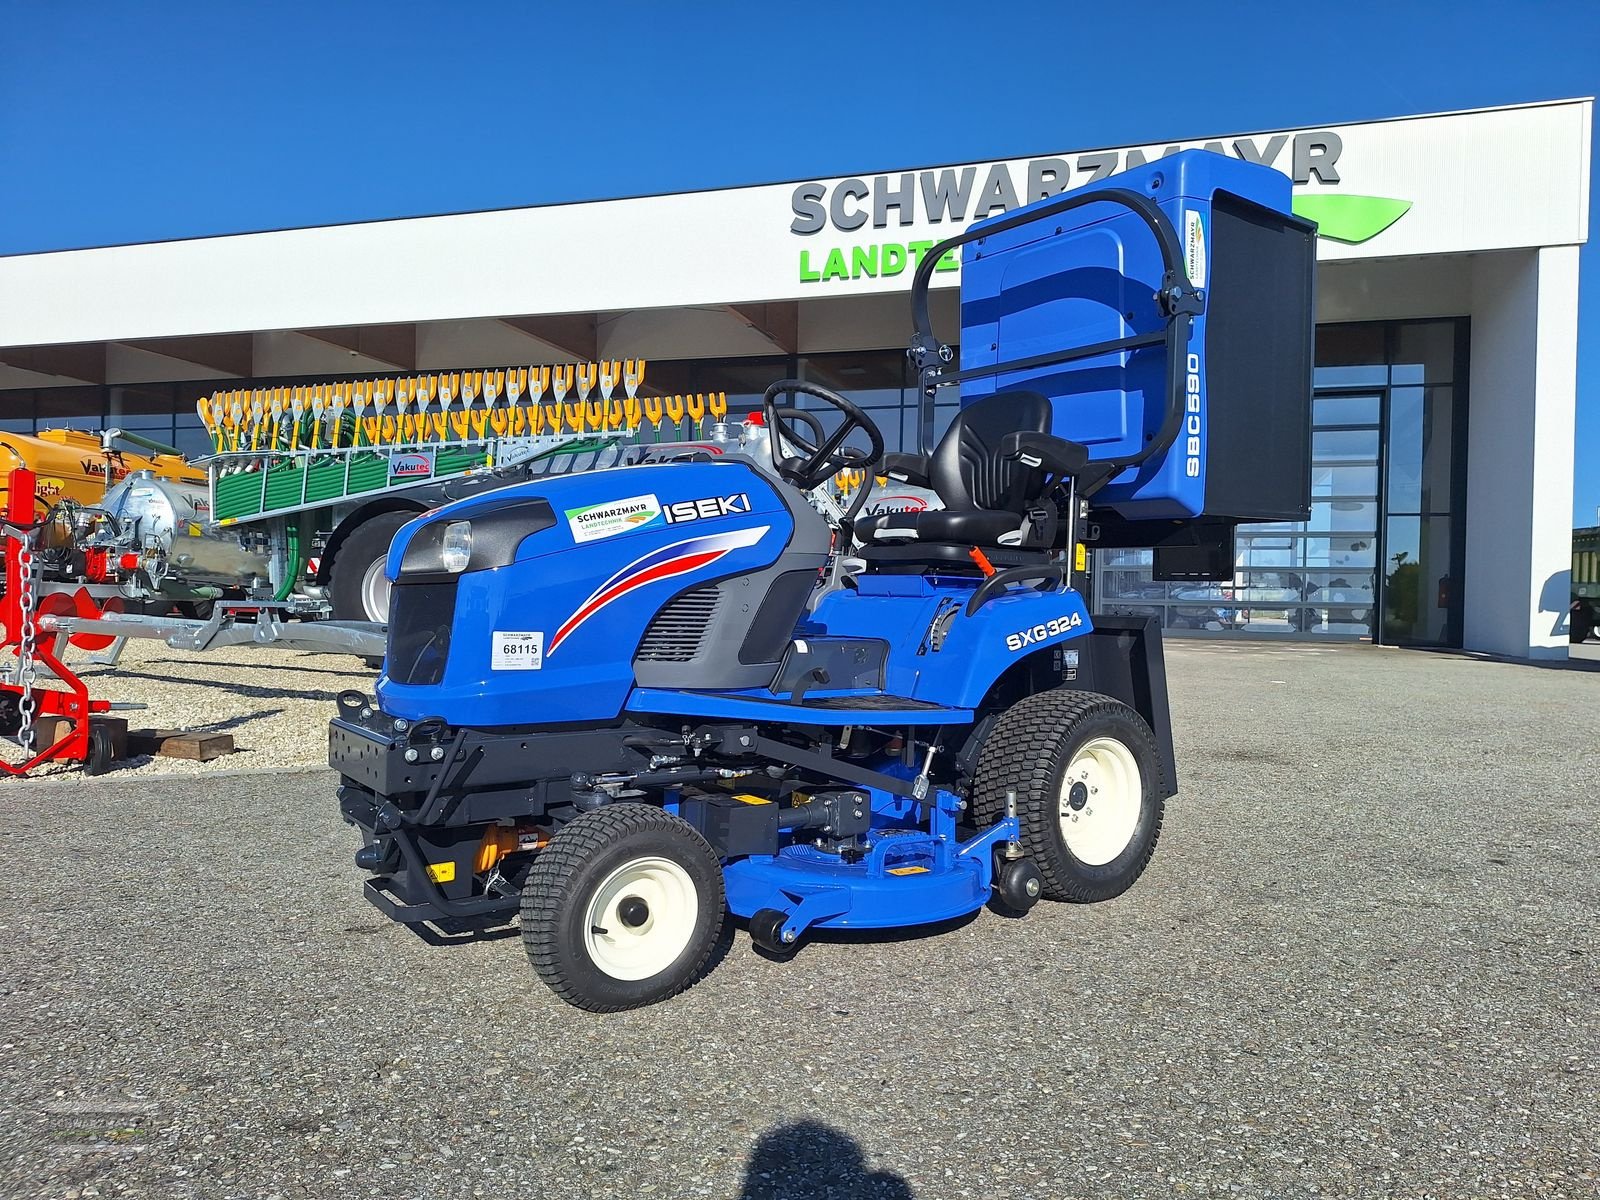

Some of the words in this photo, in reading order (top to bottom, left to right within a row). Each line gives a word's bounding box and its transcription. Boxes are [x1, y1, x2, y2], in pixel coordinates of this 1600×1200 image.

[799, 239, 962, 283] LANDTE
[1186, 353, 1200, 478] SBC590
[80, 459, 132, 476] Vaktec
[393, 461, 430, 475] Vakutec
[577, 503, 647, 523] SCHWARZMAYR
[662, 492, 752, 525] ISEKI
[1006, 612, 1082, 652] SXG324
[503, 644, 538, 655] 68115
